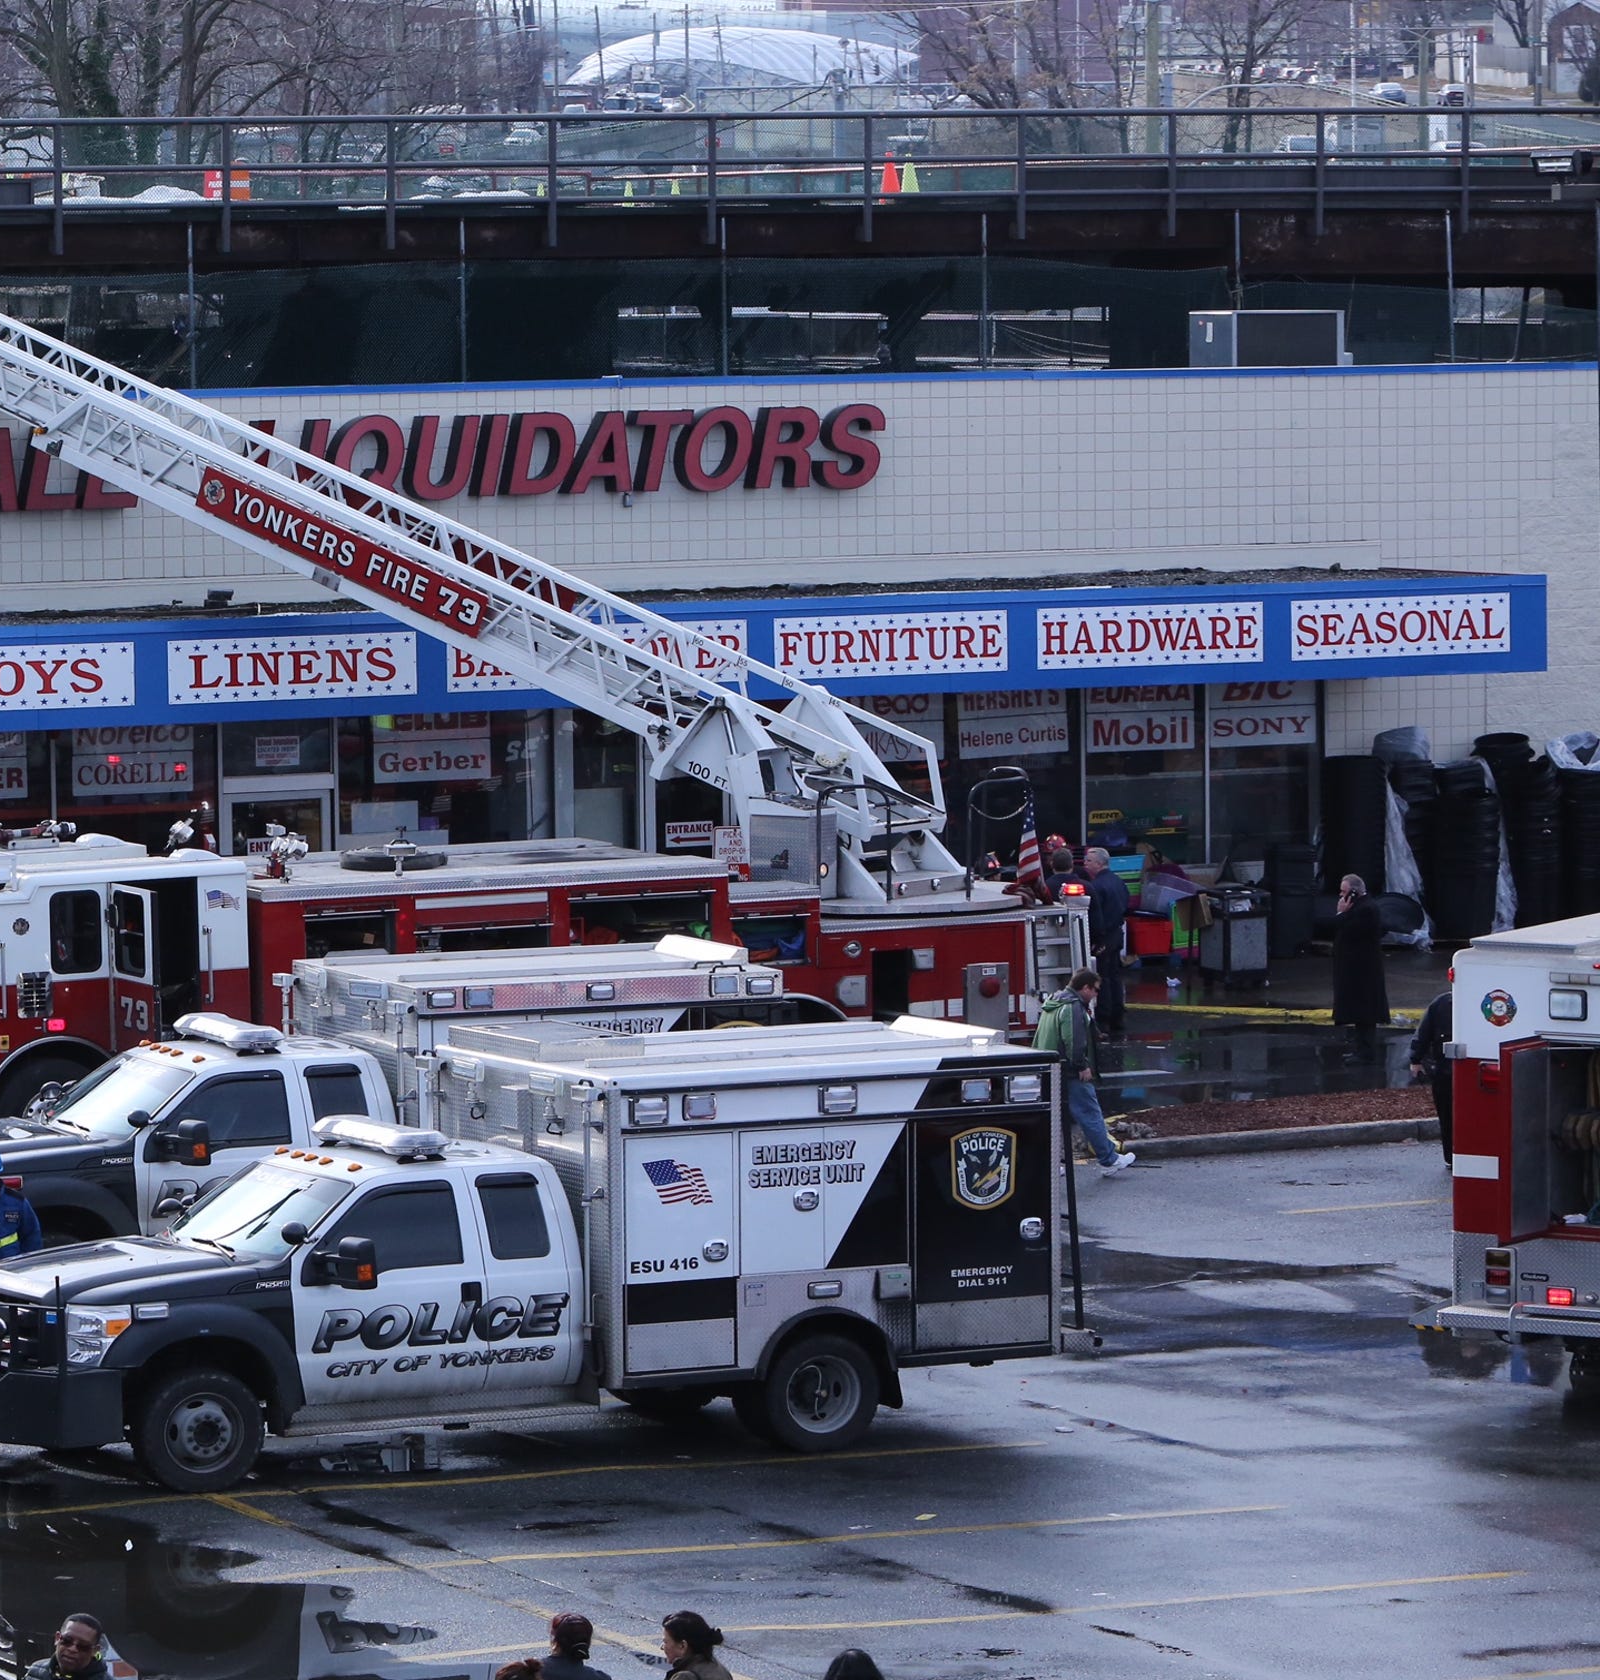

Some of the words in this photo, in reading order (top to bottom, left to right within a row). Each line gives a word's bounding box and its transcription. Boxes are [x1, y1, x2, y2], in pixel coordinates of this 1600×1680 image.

[232, 489, 356, 568] YONKERS
[366, 551, 427, 603] FIRE
[436, 584, 481, 626] 73
[1042, 614, 1259, 656] HARDWARE
[1295, 607, 1505, 648] SEASONAL
[780, 624, 1004, 667] FURNITURE
[188, 647, 397, 690] LINENS
[1221, 682, 1295, 702] BIC
[77, 725, 190, 746] Norelco
[960, 731, 1013, 748] Helene
[1017, 725, 1067, 744] Curtis
[1092, 716, 1189, 747] Mobil
[1212, 715, 1311, 737] SONY
[77, 761, 188, 786] CORELLE
[377, 751, 486, 774] Gerber
[688, 760, 711, 781] 100
[714, 774, 728, 790] FT.
[1091, 811, 1121, 820] RENT
[667, 823, 713, 835] ENTRANCE
[726, 855, 743, 863] ONLY
[729, 864, 740, 872] NO
[120, 994, 150, 1032] 73
[959, 1135, 971, 1143] CITY
[981, 1132, 1008, 1140] YONKERS
[961, 1137, 1006, 1154] POLICE
[751, 1139, 857, 1166] EMERGENCY
[748, 1163, 821, 1188] SERVICE
[823, 1162, 866, 1184] UNIT
[630, 1259, 665, 1275] ESU
[669, 1256, 699, 1271] 416
[950, 1264, 1013, 1279] EMERGENCY
[957, 1278, 986, 1288] DIAL
[987, 1276, 1009, 1287] 911
[312, 1292, 570, 1354] POLICE
[326, 1358, 391, 1379] CITY
[393, 1354, 431, 1373] OF
[438, 1345, 556, 1369] YONKERS
